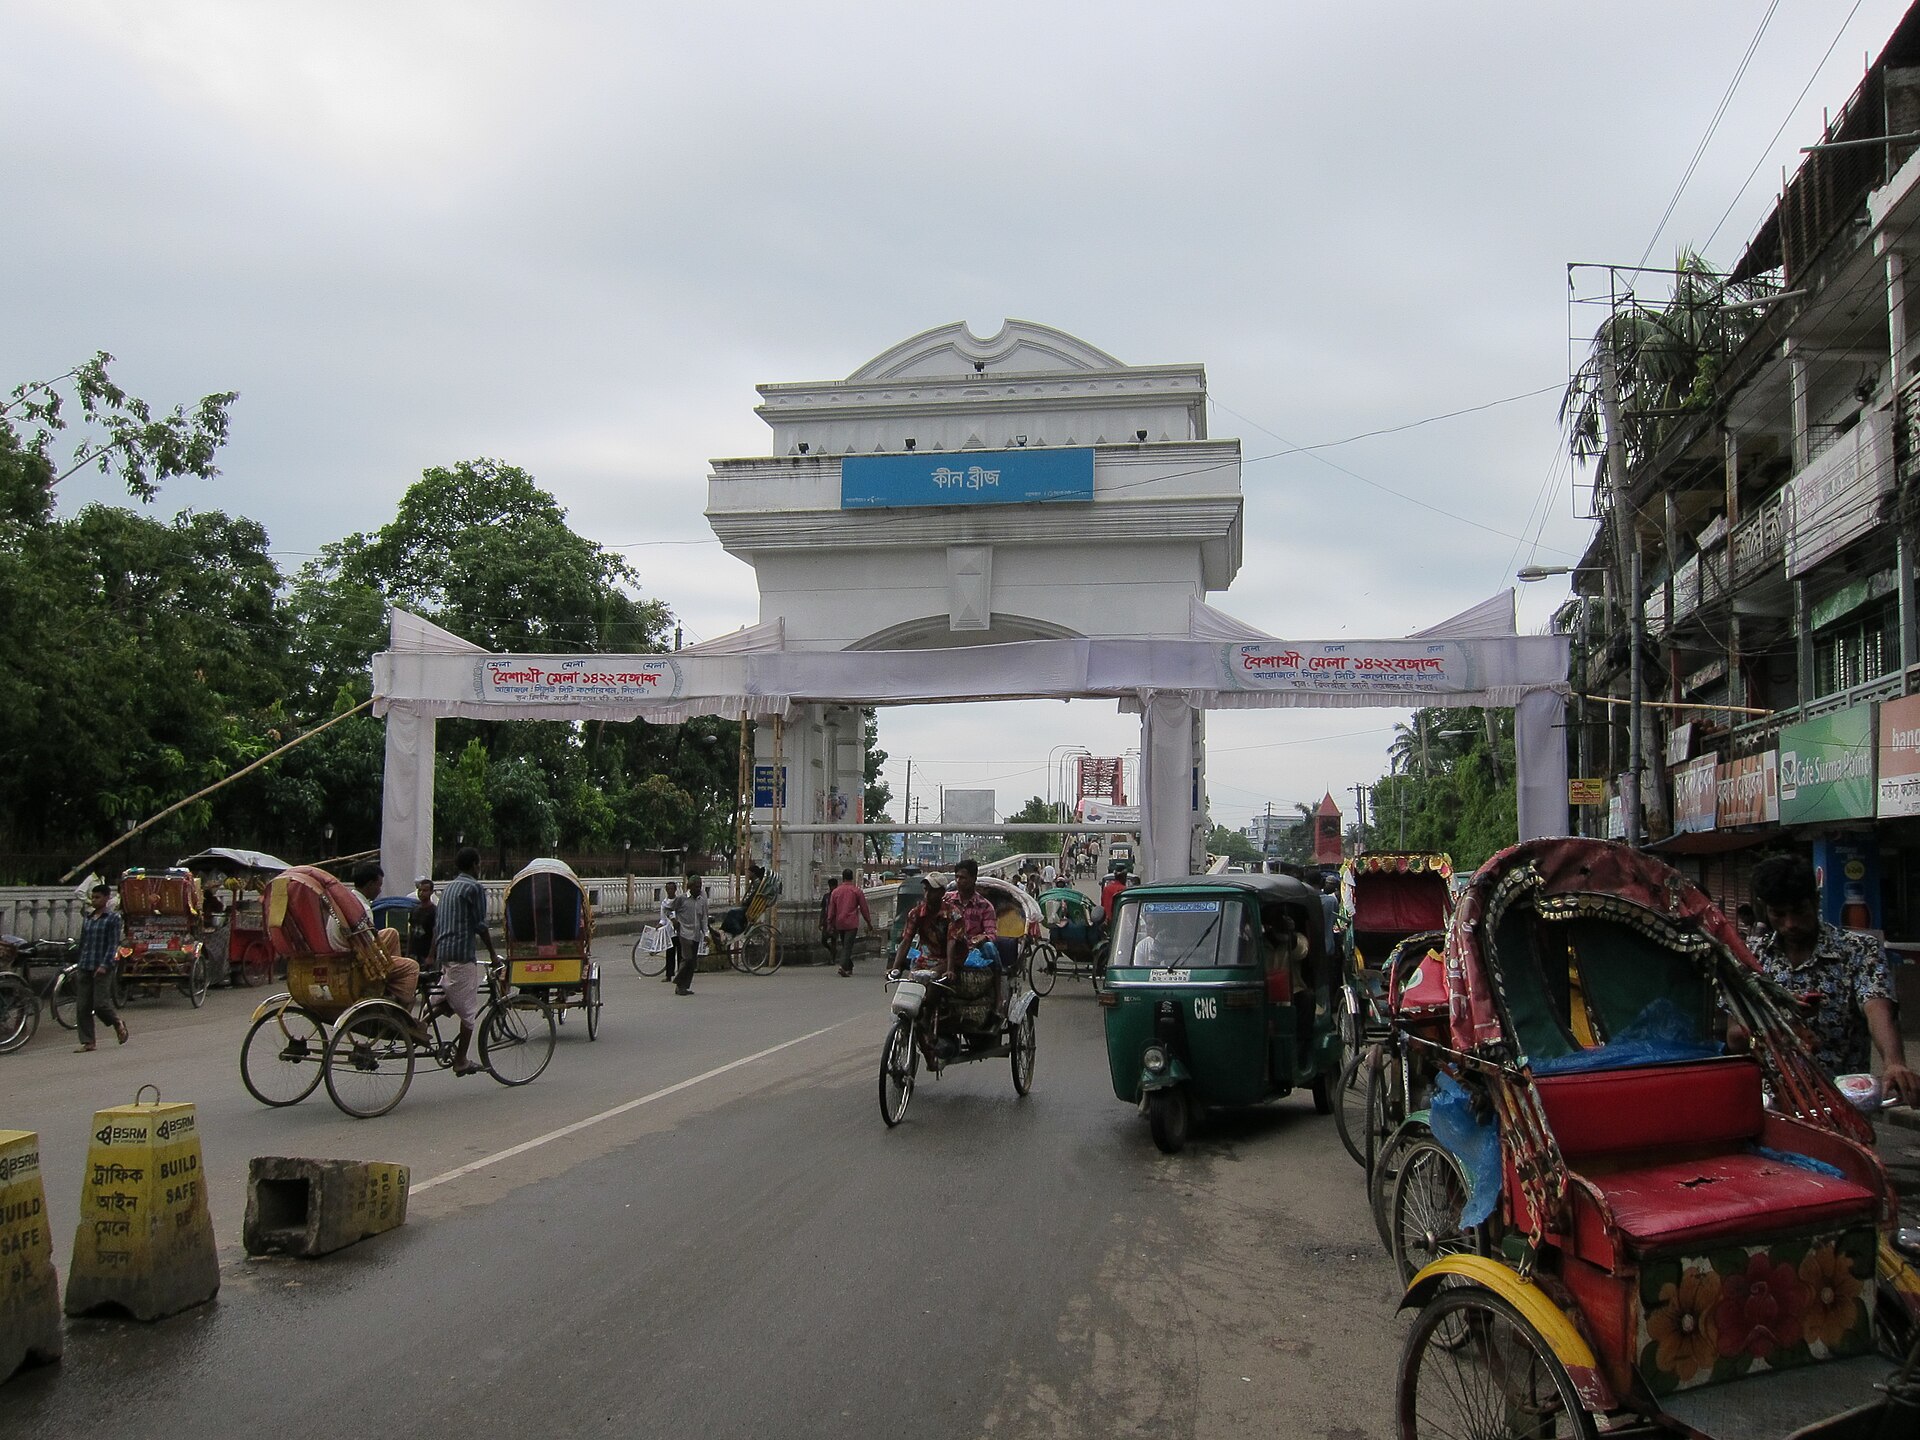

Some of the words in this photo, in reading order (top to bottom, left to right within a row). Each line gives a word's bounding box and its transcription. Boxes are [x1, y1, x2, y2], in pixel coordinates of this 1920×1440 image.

[931, 467, 964, 489] কীন
[966, 465, 1000, 490] ব্রীজ
[1324, 645, 1345, 653] মেলা
[487, 661, 511, 670] মেলা
[562, 660, 586, 670] মেলা
[643, 661, 668, 670] মেলা
[1241, 650, 1305, 670] বৈশাখী
[1309, 656, 1350, 671] মেলা
[1354, 658, 1398, 672] ১৪২২
[489, 667, 545, 685] বৈশাখী
[547, 671, 581, 685] মেলা
[583, 672, 618, 686] ১৪২২
[1814, 757, 1842, 784] Surma
[1194, 997, 1217, 1020] CNG
[113, 1127, 147, 1139] BSRM
[169, 1115, 195, 1132] BSRM
[9, 1152, 40, 1171] BSRM
[160, 1154, 197, 1180] BUILD
[92, 1162, 144, 1186] ট্রাফিক
[96, 1191, 138, 1213] আইন
[166, 1181, 196, 1204] SAFE
[95, 1220, 130, 1237] মেনে
[2, 1227, 40, 1256] SAFE
